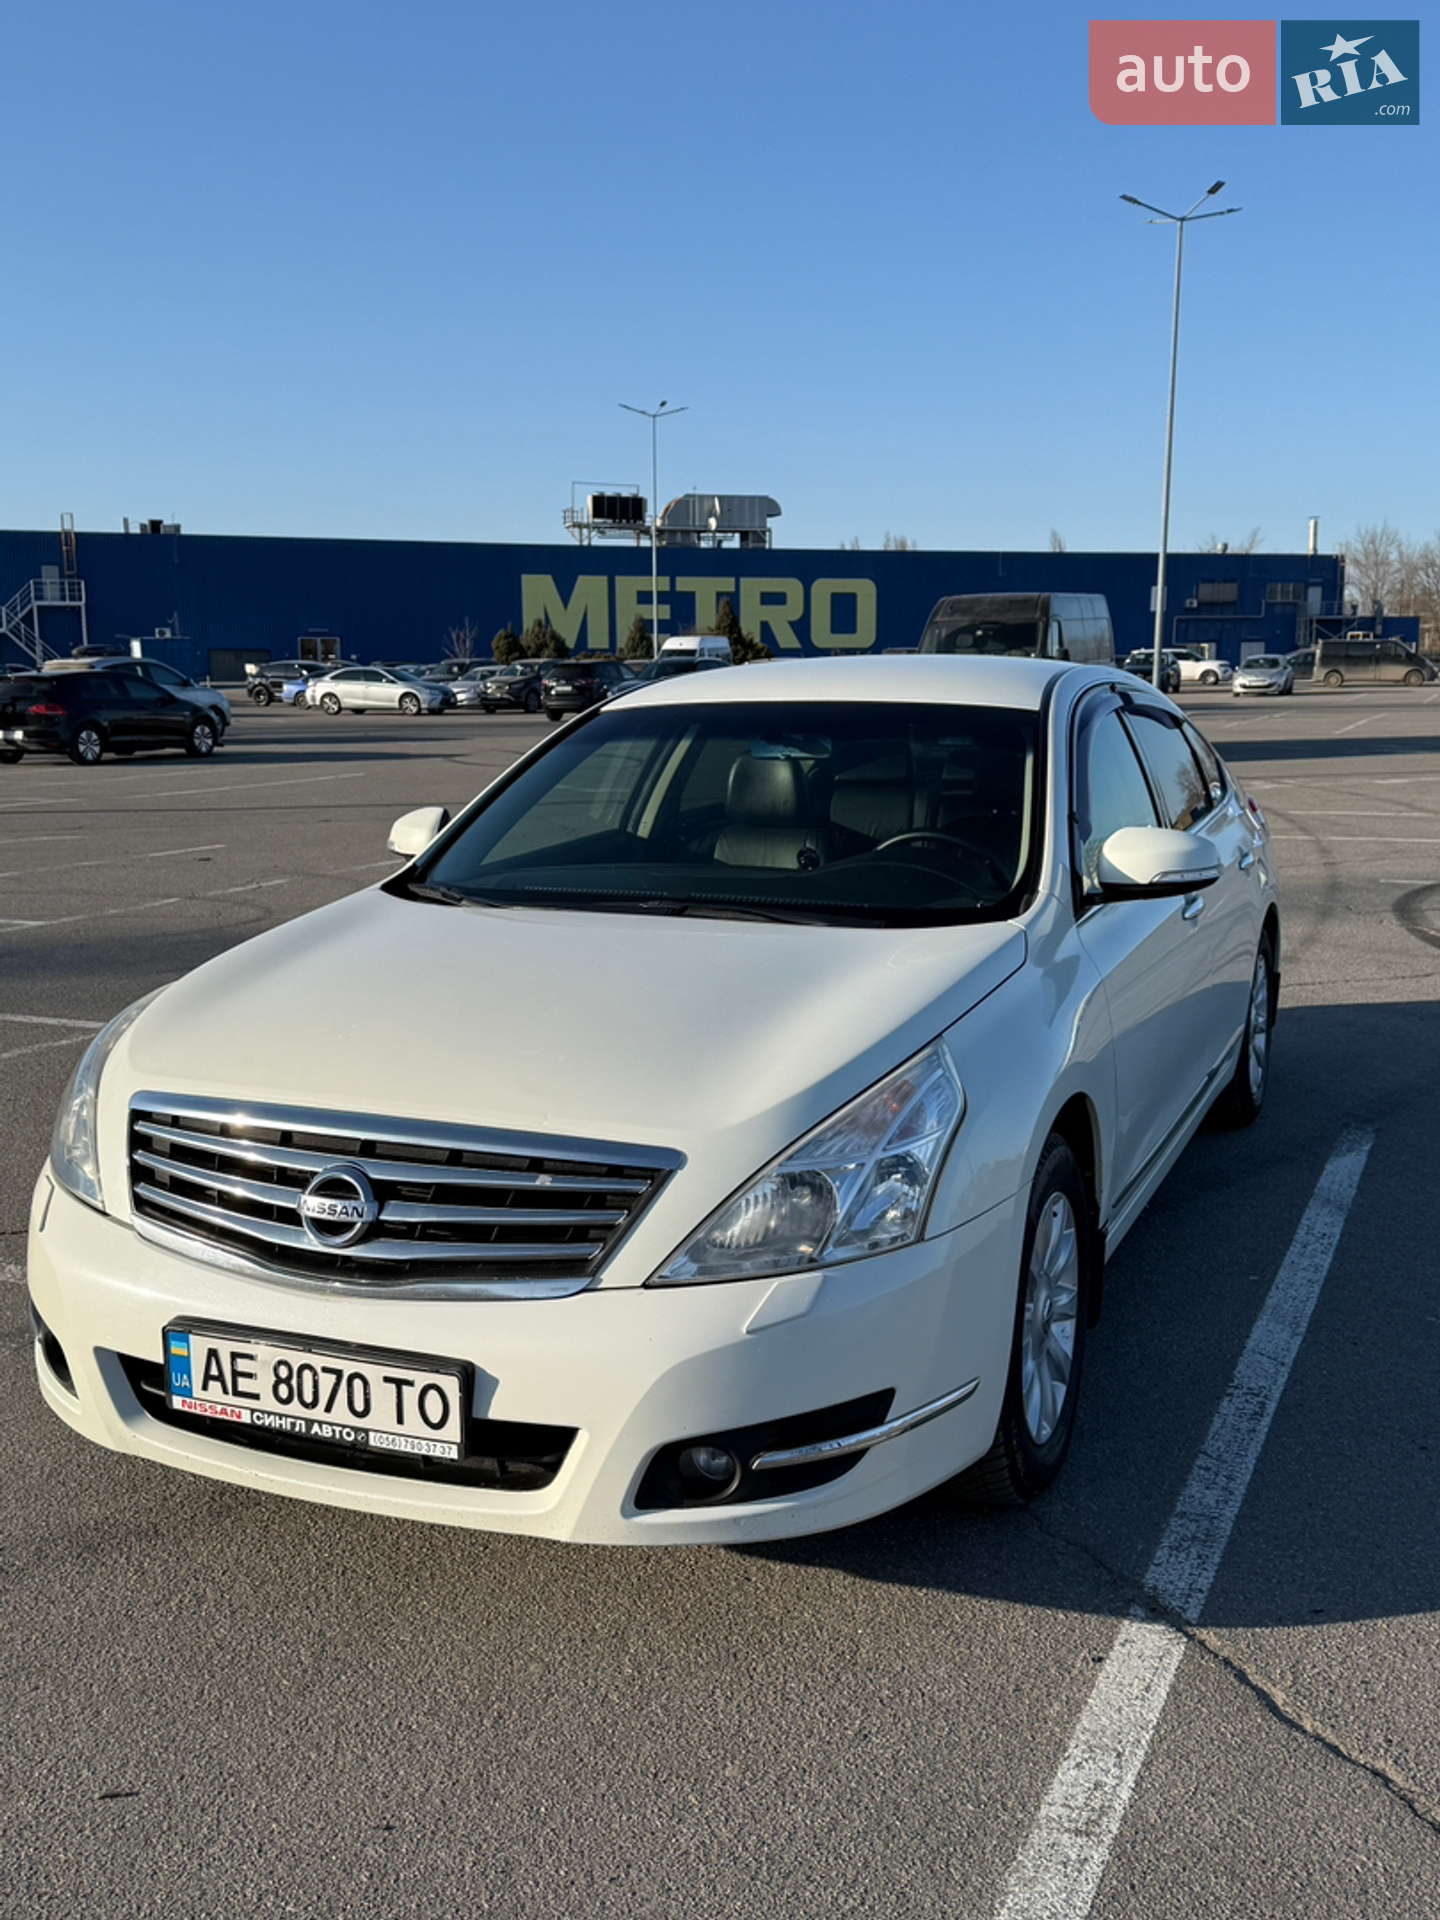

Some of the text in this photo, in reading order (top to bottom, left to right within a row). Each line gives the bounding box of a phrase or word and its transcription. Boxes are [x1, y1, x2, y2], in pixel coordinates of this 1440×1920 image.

[521, 574, 877, 648] METRO
[172, 1372, 190, 1388] UA
[201, 1347, 450, 1431] AE 8070 TO
[181, 1398, 242, 1421] NISSAN
[253, 1411, 355, 1441] СИНГЛ АВТО
